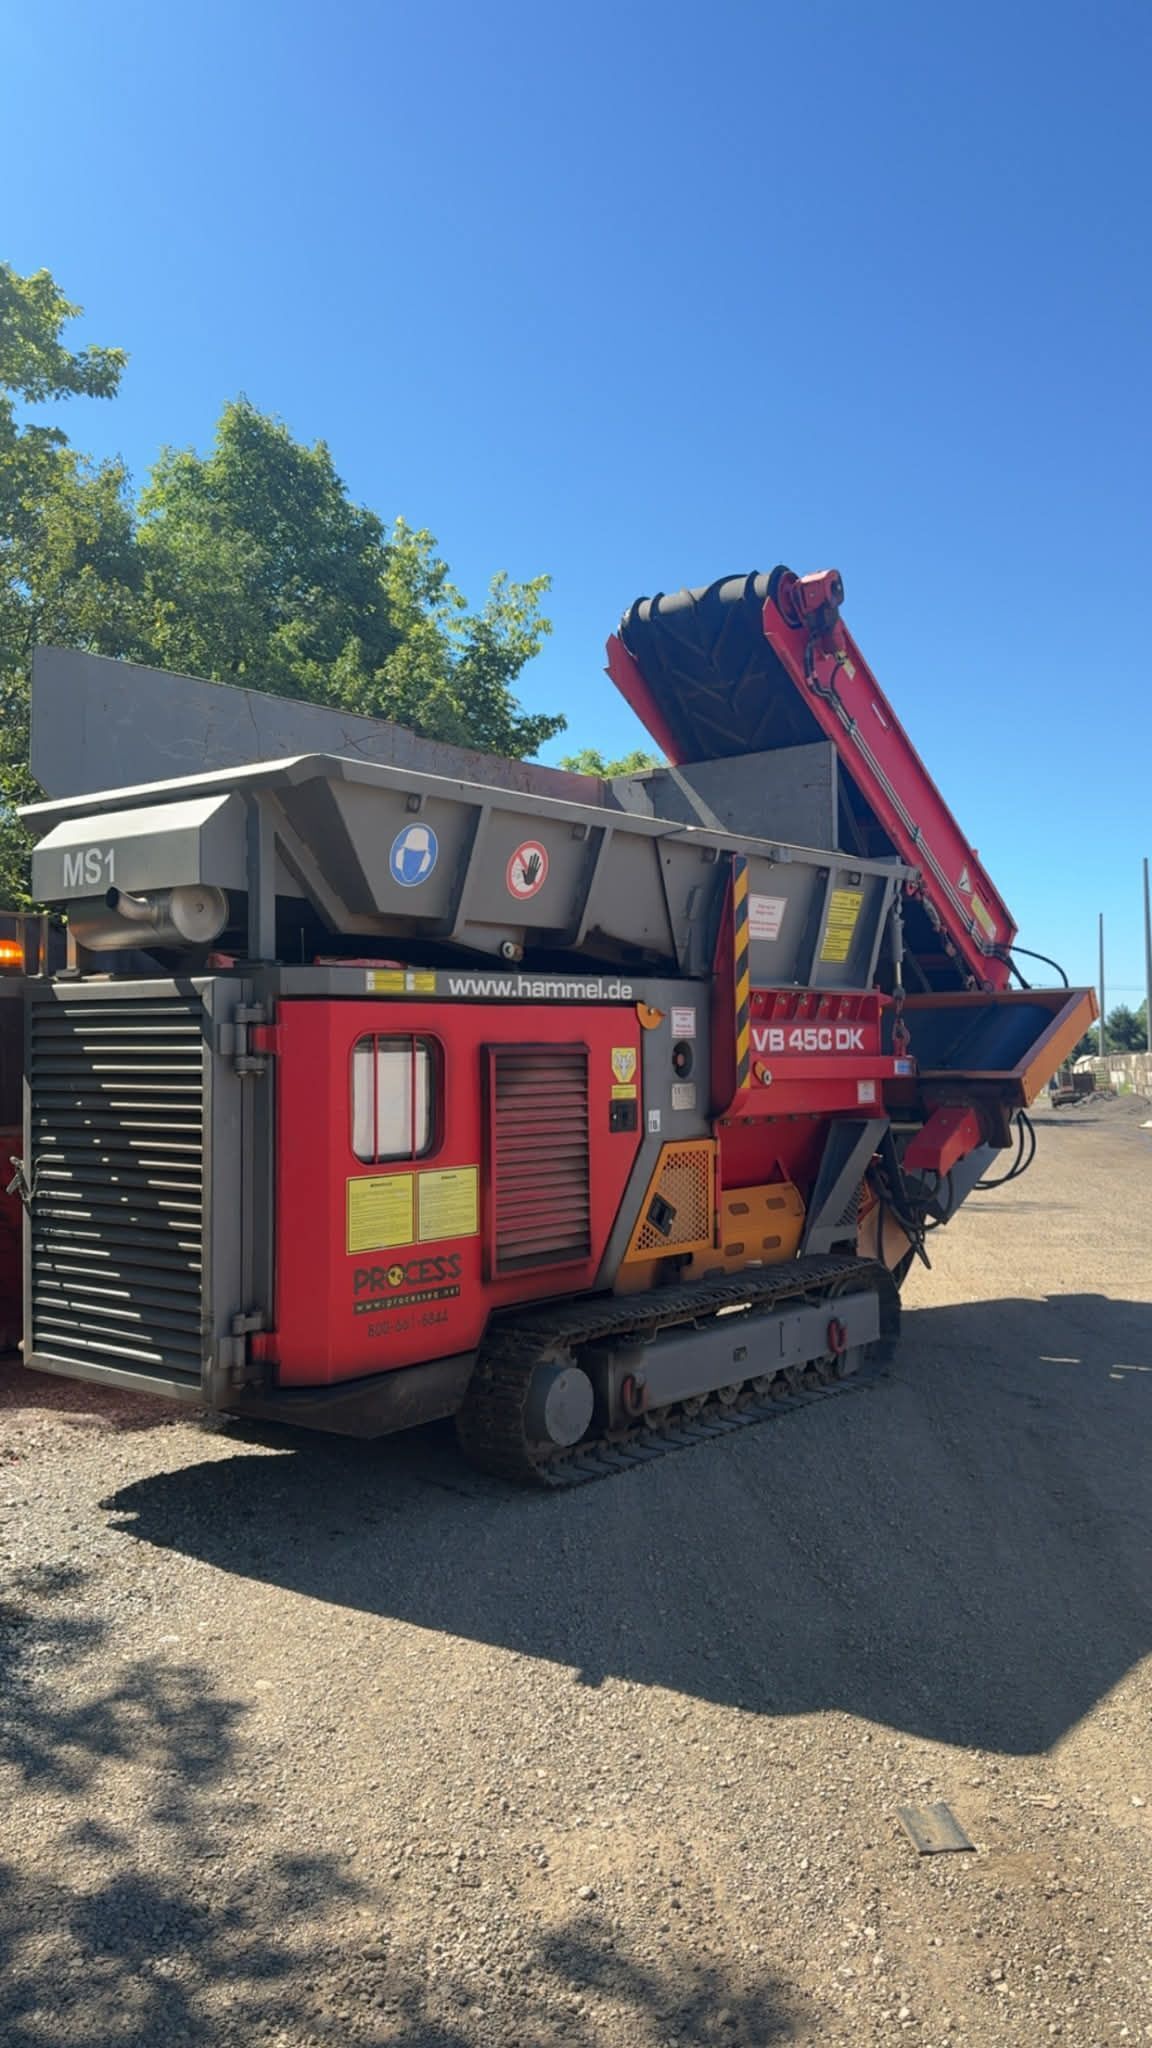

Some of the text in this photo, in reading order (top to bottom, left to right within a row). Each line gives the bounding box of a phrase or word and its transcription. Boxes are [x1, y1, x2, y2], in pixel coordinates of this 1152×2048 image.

[63, 847, 115, 888] MS1
[449, 975, 633, 999] www.hammel.de
[752, 1028, 865, 1051] VB 450 DK
[353, 1253, 462, 1296] PROCESS
